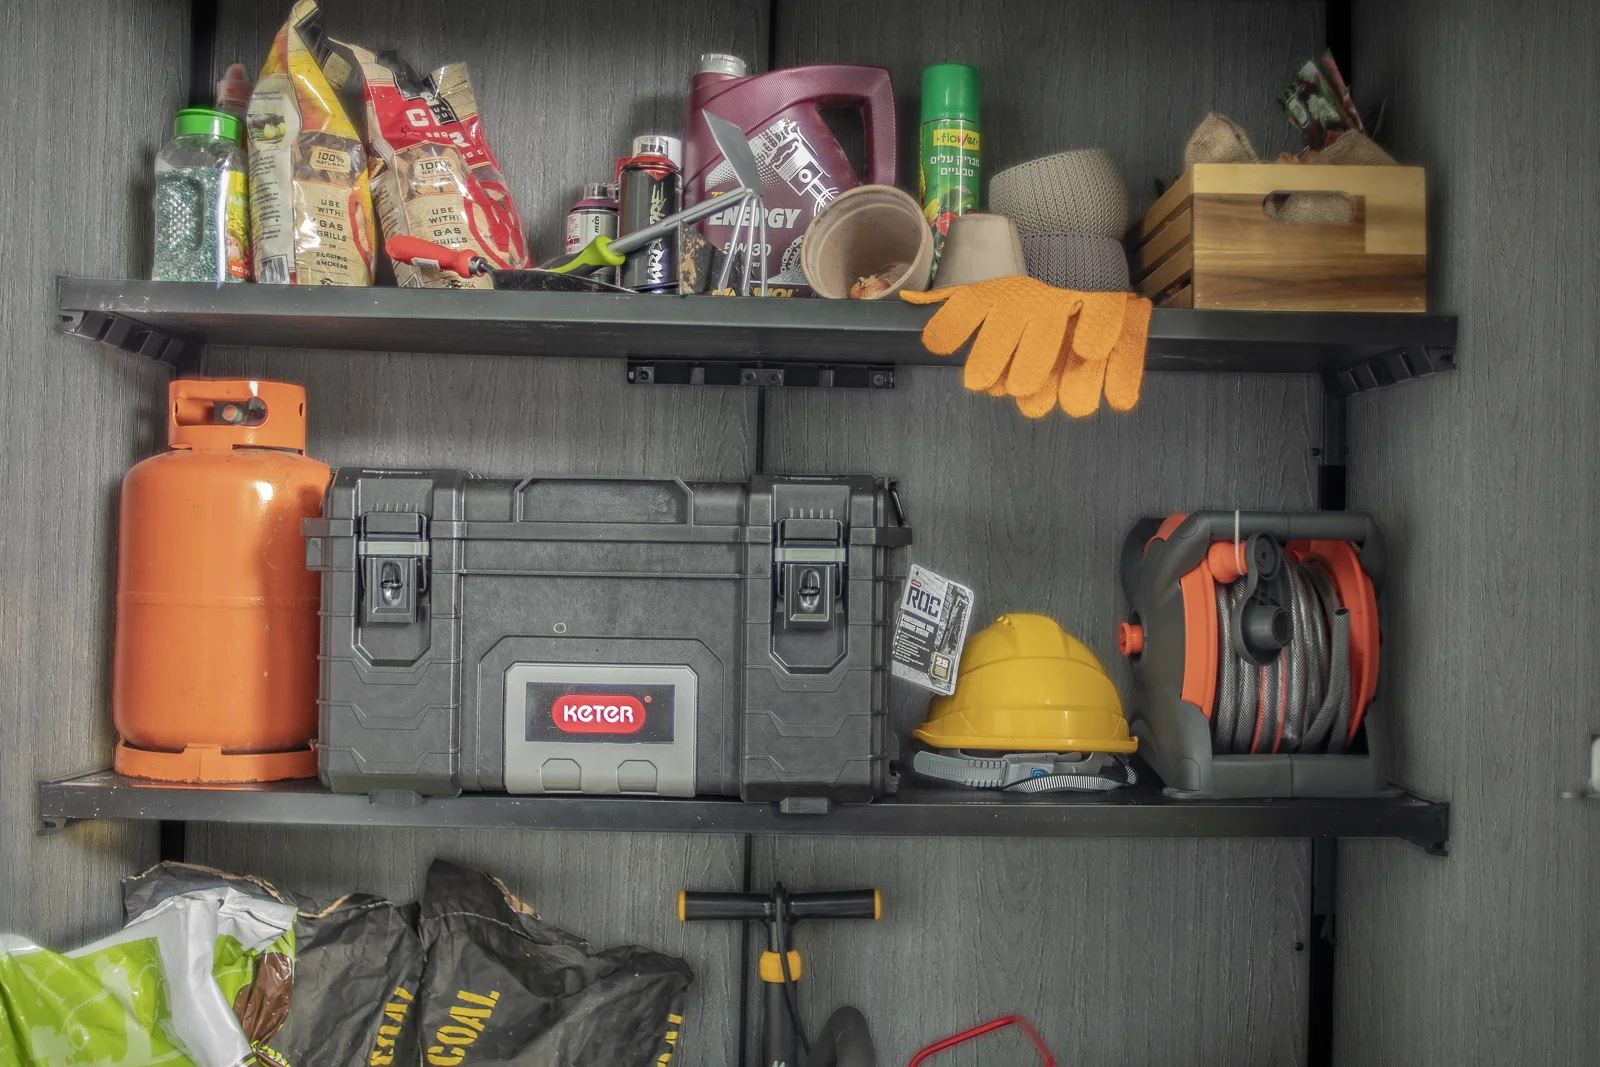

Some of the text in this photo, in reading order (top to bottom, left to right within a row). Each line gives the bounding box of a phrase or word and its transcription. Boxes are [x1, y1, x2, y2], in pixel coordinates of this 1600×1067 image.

[318, 152, 344, 164] 100%
[930, 154, 954, 164] עלים
[316, 160, 345, 168] NATURAL
[320, 199, 340, 208] USE
[317, 206, 344, 217] WITH:
[320, 220, 343, 231] GAS
[316, 230, 346, 242] GRILLS
[434, 228, 462, 236] GAS
[906, 586, 941, 618] ROC
[564, 705, 634, 723] KETER
[427, 990, 500, 1066] COAL
